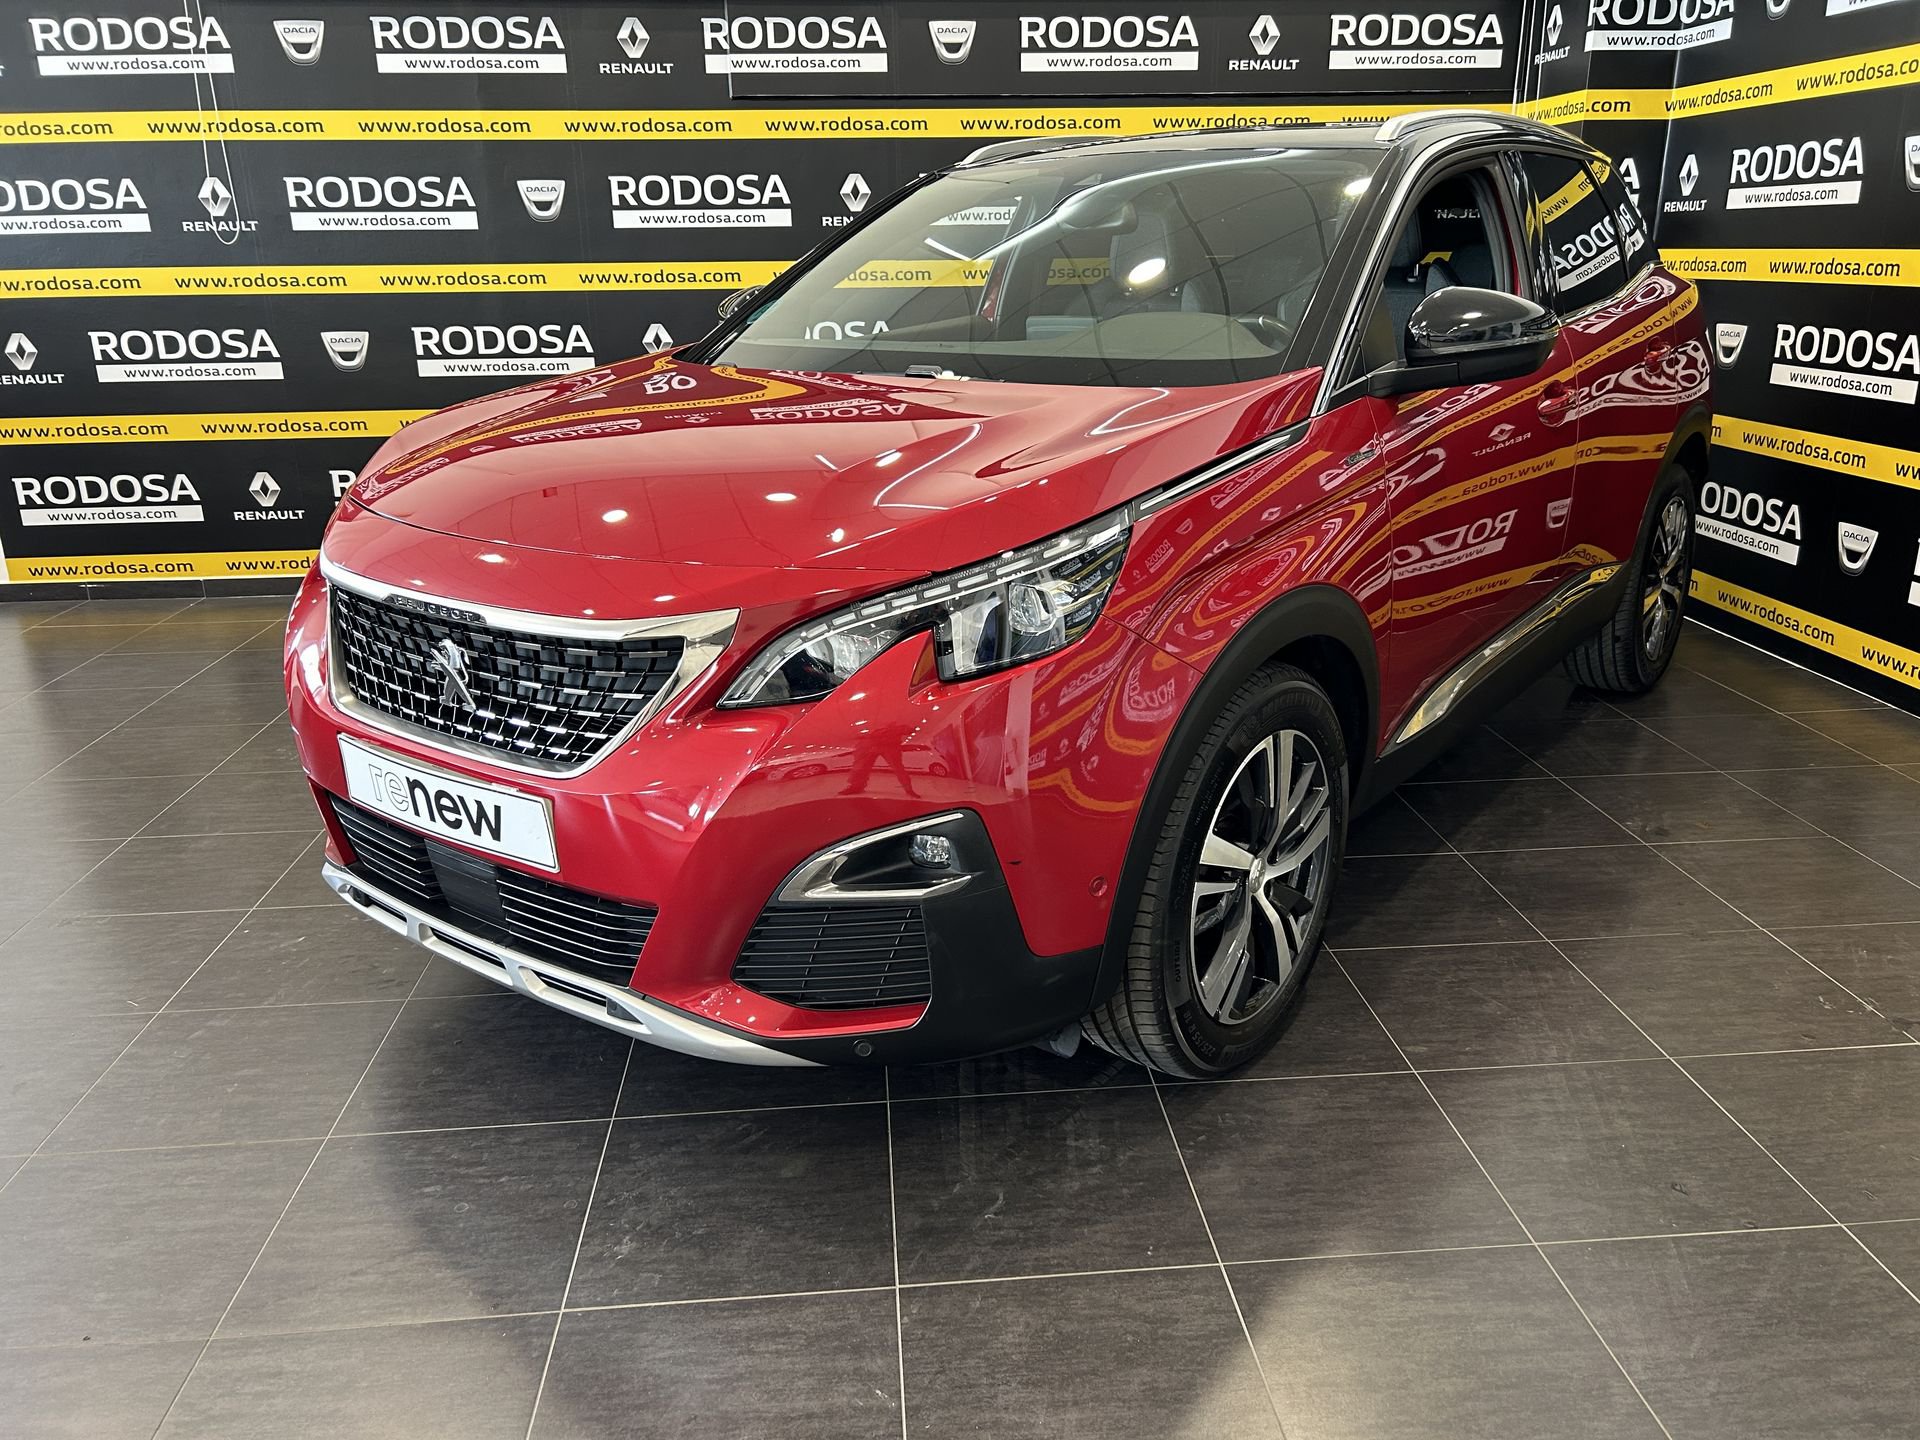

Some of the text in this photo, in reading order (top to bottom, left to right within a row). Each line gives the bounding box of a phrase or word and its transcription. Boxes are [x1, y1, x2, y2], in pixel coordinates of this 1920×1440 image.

[28, 16, 231, 52] RODOSA
[282, 25, 317, 35] DACIA
[368, 16, 565, 50] RODOSA
[700, 16, 888, 50] RODOSA
[936, 26, 968, 35] DACIA
[1019, 15, 1200, 49] RODOSA
[1330, 13, 1504, 47] RODOSA
[1606, 26, 1716, 47] www.rodosa.com
[404, 57, 540, 71] www.rodosa.com
[731, 56, 862, 70] www.rodosa.com
[1046, 55, 1172, 69] www.rodosa.com
[1354, 53, 1477, 66] www.rodosa.com
[1534, 46, 1571, 65] RENAULT
[66, 57, 207, 72] www.rodosa.com
[599, 63, 674, 74] RENAULT
[1228, 58, 1300, 71] RENAULT
[1663, 81, 1773, 113] www.rodosa.com
[146, 117, 325, 135] www.rodosa.com
[358, 116, 532, 134] www.rodosa.com
[564, 117, 733, 134] www.rodosa.com
[764, 115, 929, 132] www.rodosa.com
[960, 114, 1122, 131] www.rodosa.com
[1729, 136, 1865, 185] RODOSA
[283, 175, 477, 209] RODOSA
[525, 185, 558, 194] DACIA
[607, 173, 792, 207] RODOSA
[1744, 186, 1840, 206] www.rodosa.com
[1664, 199, 1708, 214] RENAULT
[182, 219, 260, 233] RENAULT
[317, 212, 452, 228] www.rodosa.com
[638, 211, 767, 225] www.rodosa.com
[1768, 257, 1902, 278] www.rodosa.com
[0, 275, 142, 292] w.rodosa.com
[174, 273, 348, 290] www.rodosa.com
[379, 272, 547, 289] www.rodosa.com
[578, 270, 742, 286] www.rodosa.com
[329, 336, 363, 345] DACIA
[410, 323, 595, 357] RODOSA
[1719, 330, 1742, 339] DACIA
[87, 328, 281, 361] RODOSA
[1773, 323, 1920, 375] RODOSA
[123, 363, 257, 379] www.rodosa.com
[443, 358, 571, 373] www.rodosa.com
[0, 373, 65, 385] ENAULT
[1789, 370, 1893, 396] www.rodosa.com
[0, 421, 169, 438] www.rodosa.com
[200, 417, 368, 435] www.rodosa.com
[1742, 430, 1867, 469] www.rodosa.com
[11, 473, 201, 506] RODOSA
[46, 507, 178, 522] www.rodosa.com
[233, 509, 305, 521] RENAULT
[1695, 520, 1780, 556] www.rodosa.com
[1843, 530, 1871, 544] DACIA
[28, 558, 195, 577] www.rodosa.com
[395, 596, 473, 622] PEUGEOT
[1717, 588, 1836, 647] www.rodosa.com
[368, 763, 501, 842] renew
